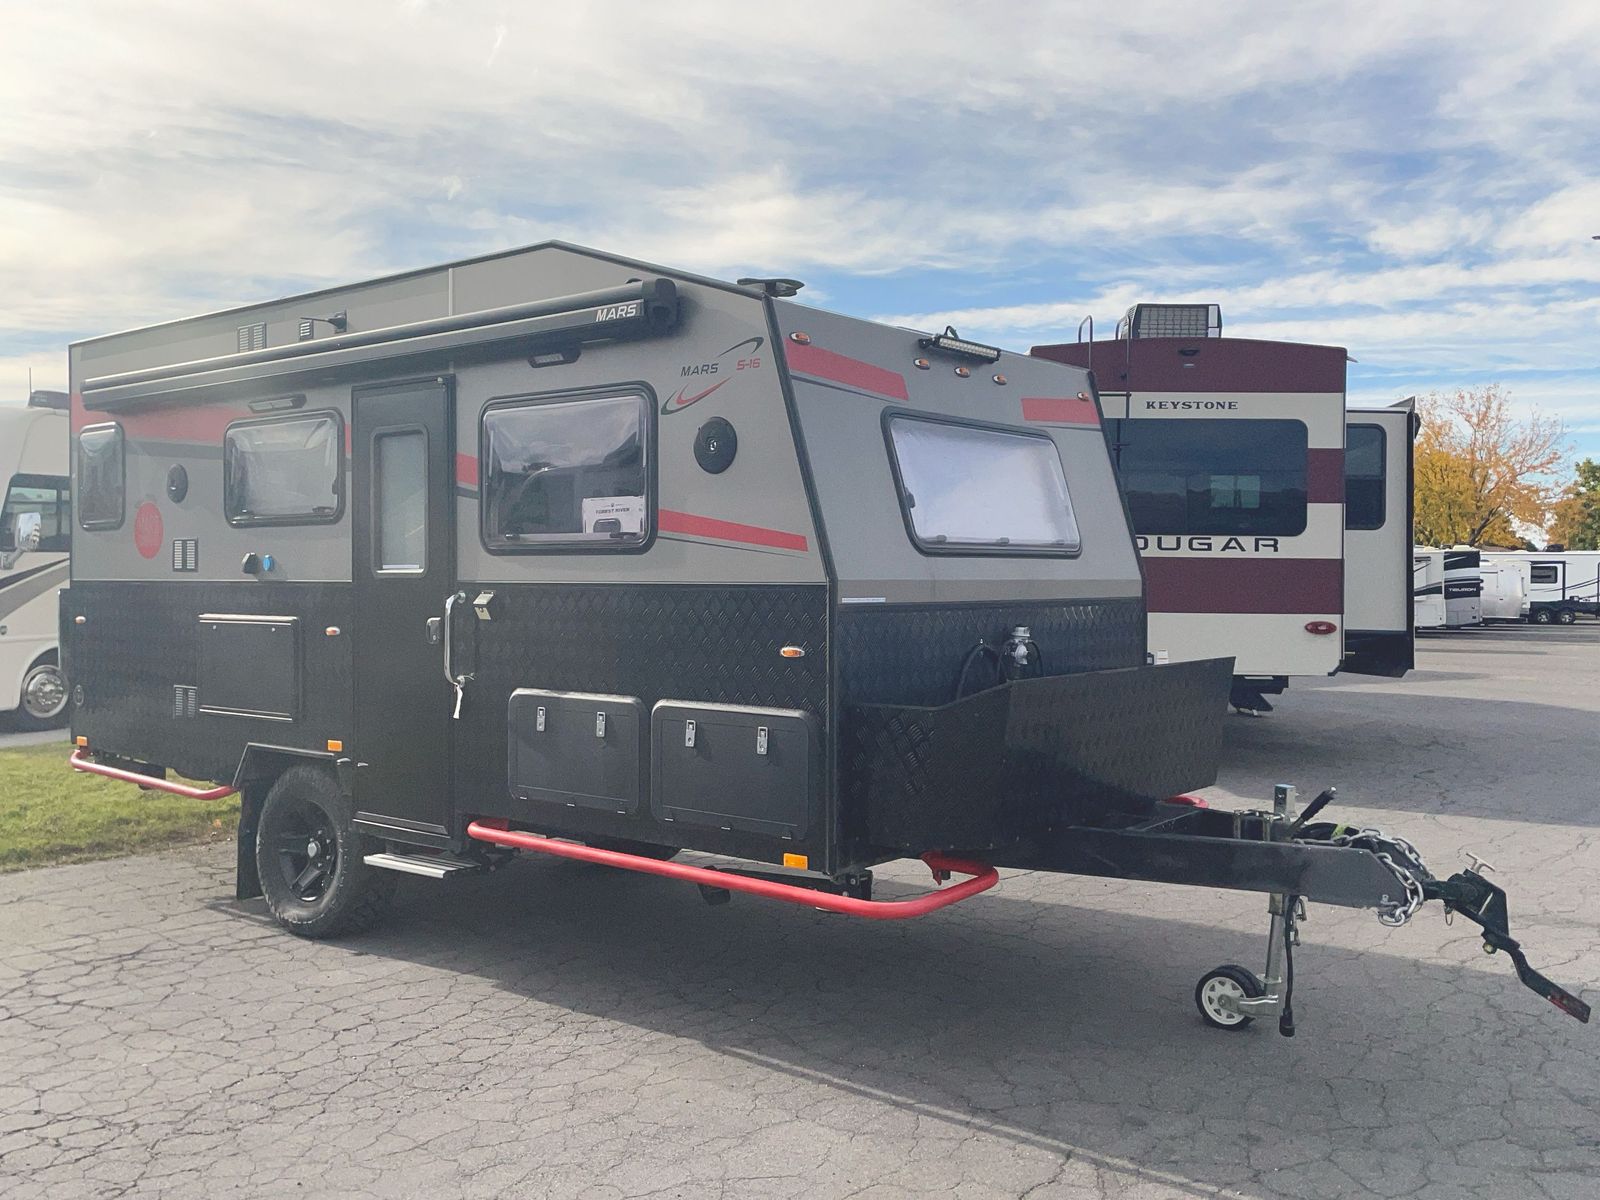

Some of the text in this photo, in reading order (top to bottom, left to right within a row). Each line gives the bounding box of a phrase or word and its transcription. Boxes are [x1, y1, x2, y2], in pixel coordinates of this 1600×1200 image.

[595, 304, 637, 322] MARS
[680, 358, 761, 377] MARS S-16
[1145, 401, 1239, 410] KEYSTONE
